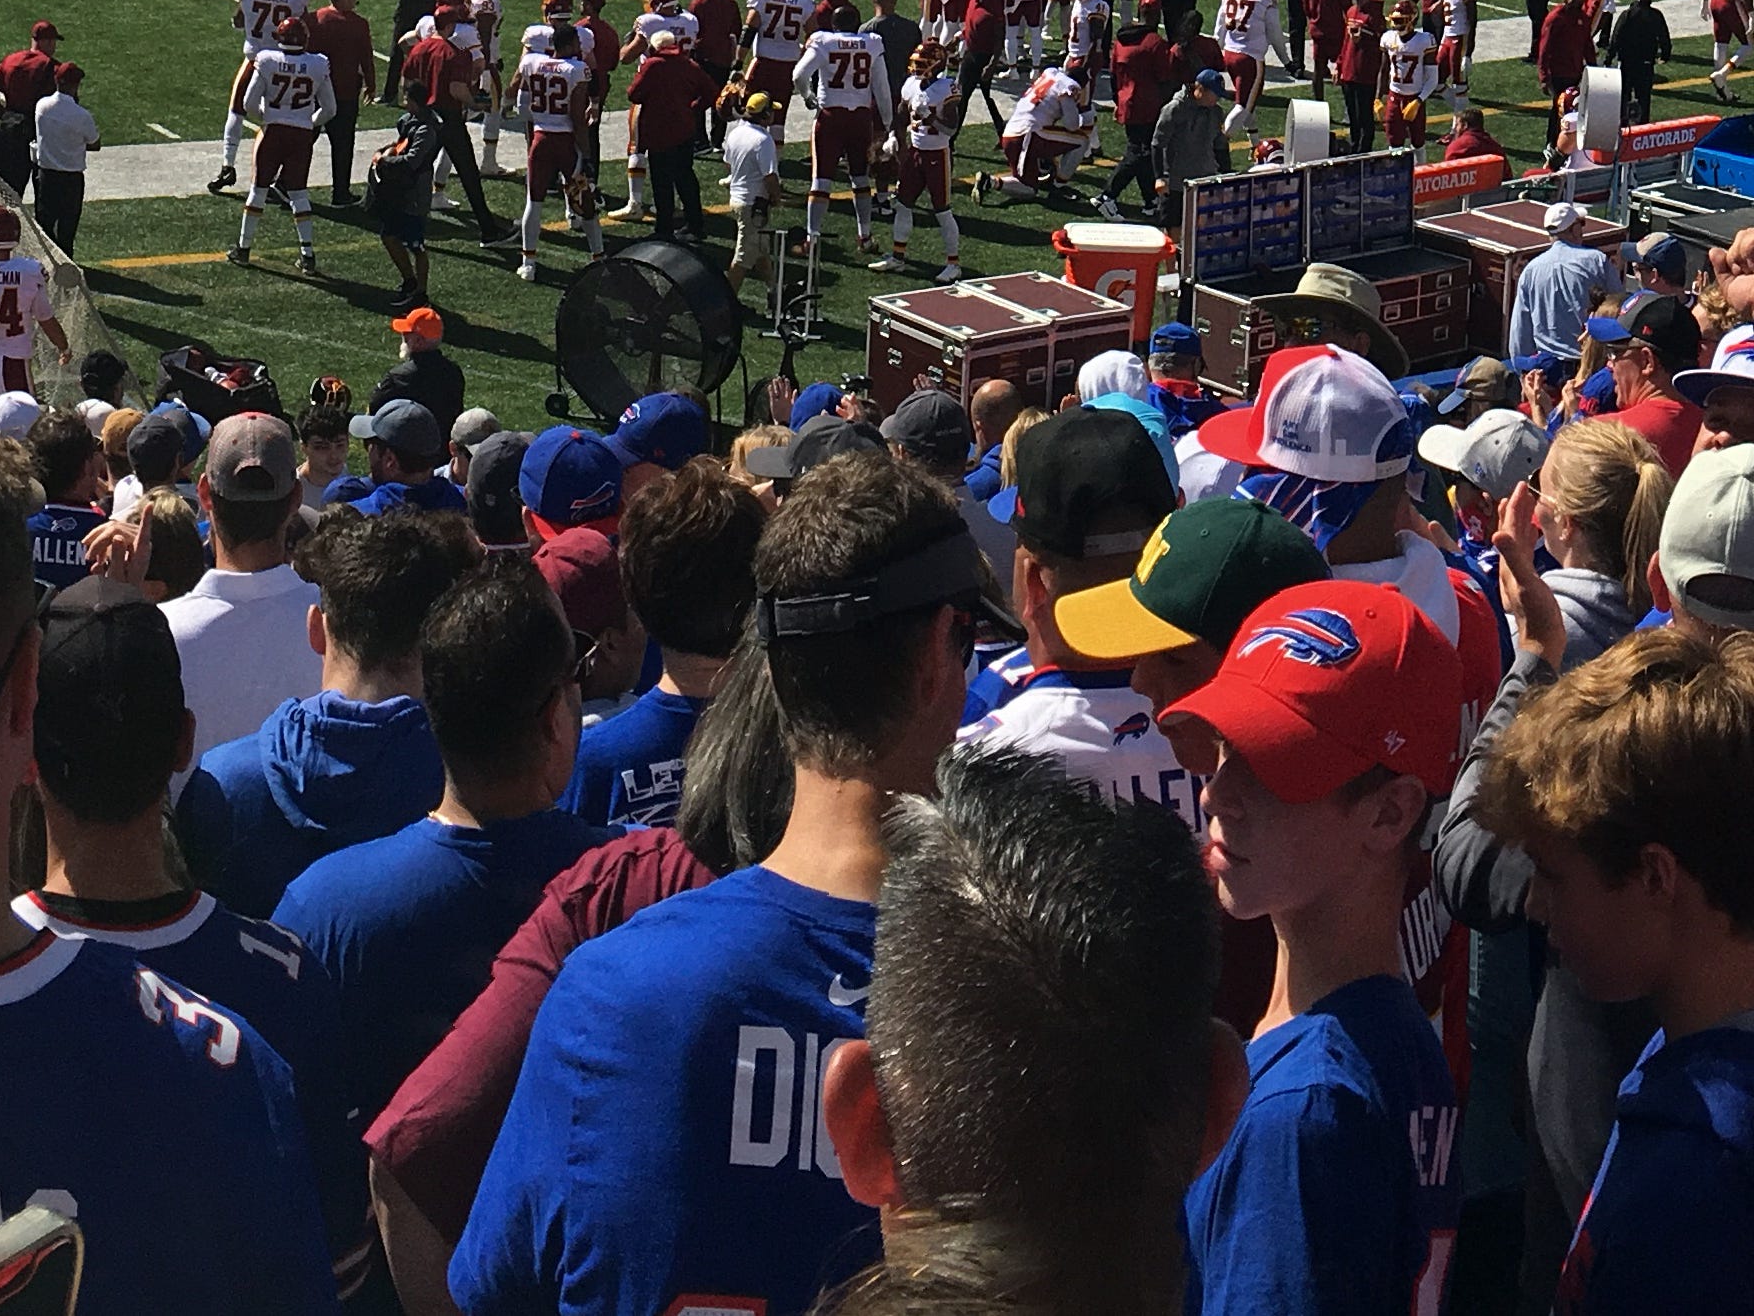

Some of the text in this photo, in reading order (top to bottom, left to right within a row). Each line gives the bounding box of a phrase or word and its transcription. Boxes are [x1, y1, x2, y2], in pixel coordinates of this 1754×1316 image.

[762, 2, 802, 41] 75
[828, 52, 873, 90] 78
[1391, 54, 1419, 85] 17
[271, 73, 314, 111] 72
[530, 73, 569, 115] 82
[1632, 126, 1697, 152] GATORADE
[1414, 169, 1478, 195] ATORADE
[32, 536, 87, 566] ALLEN
